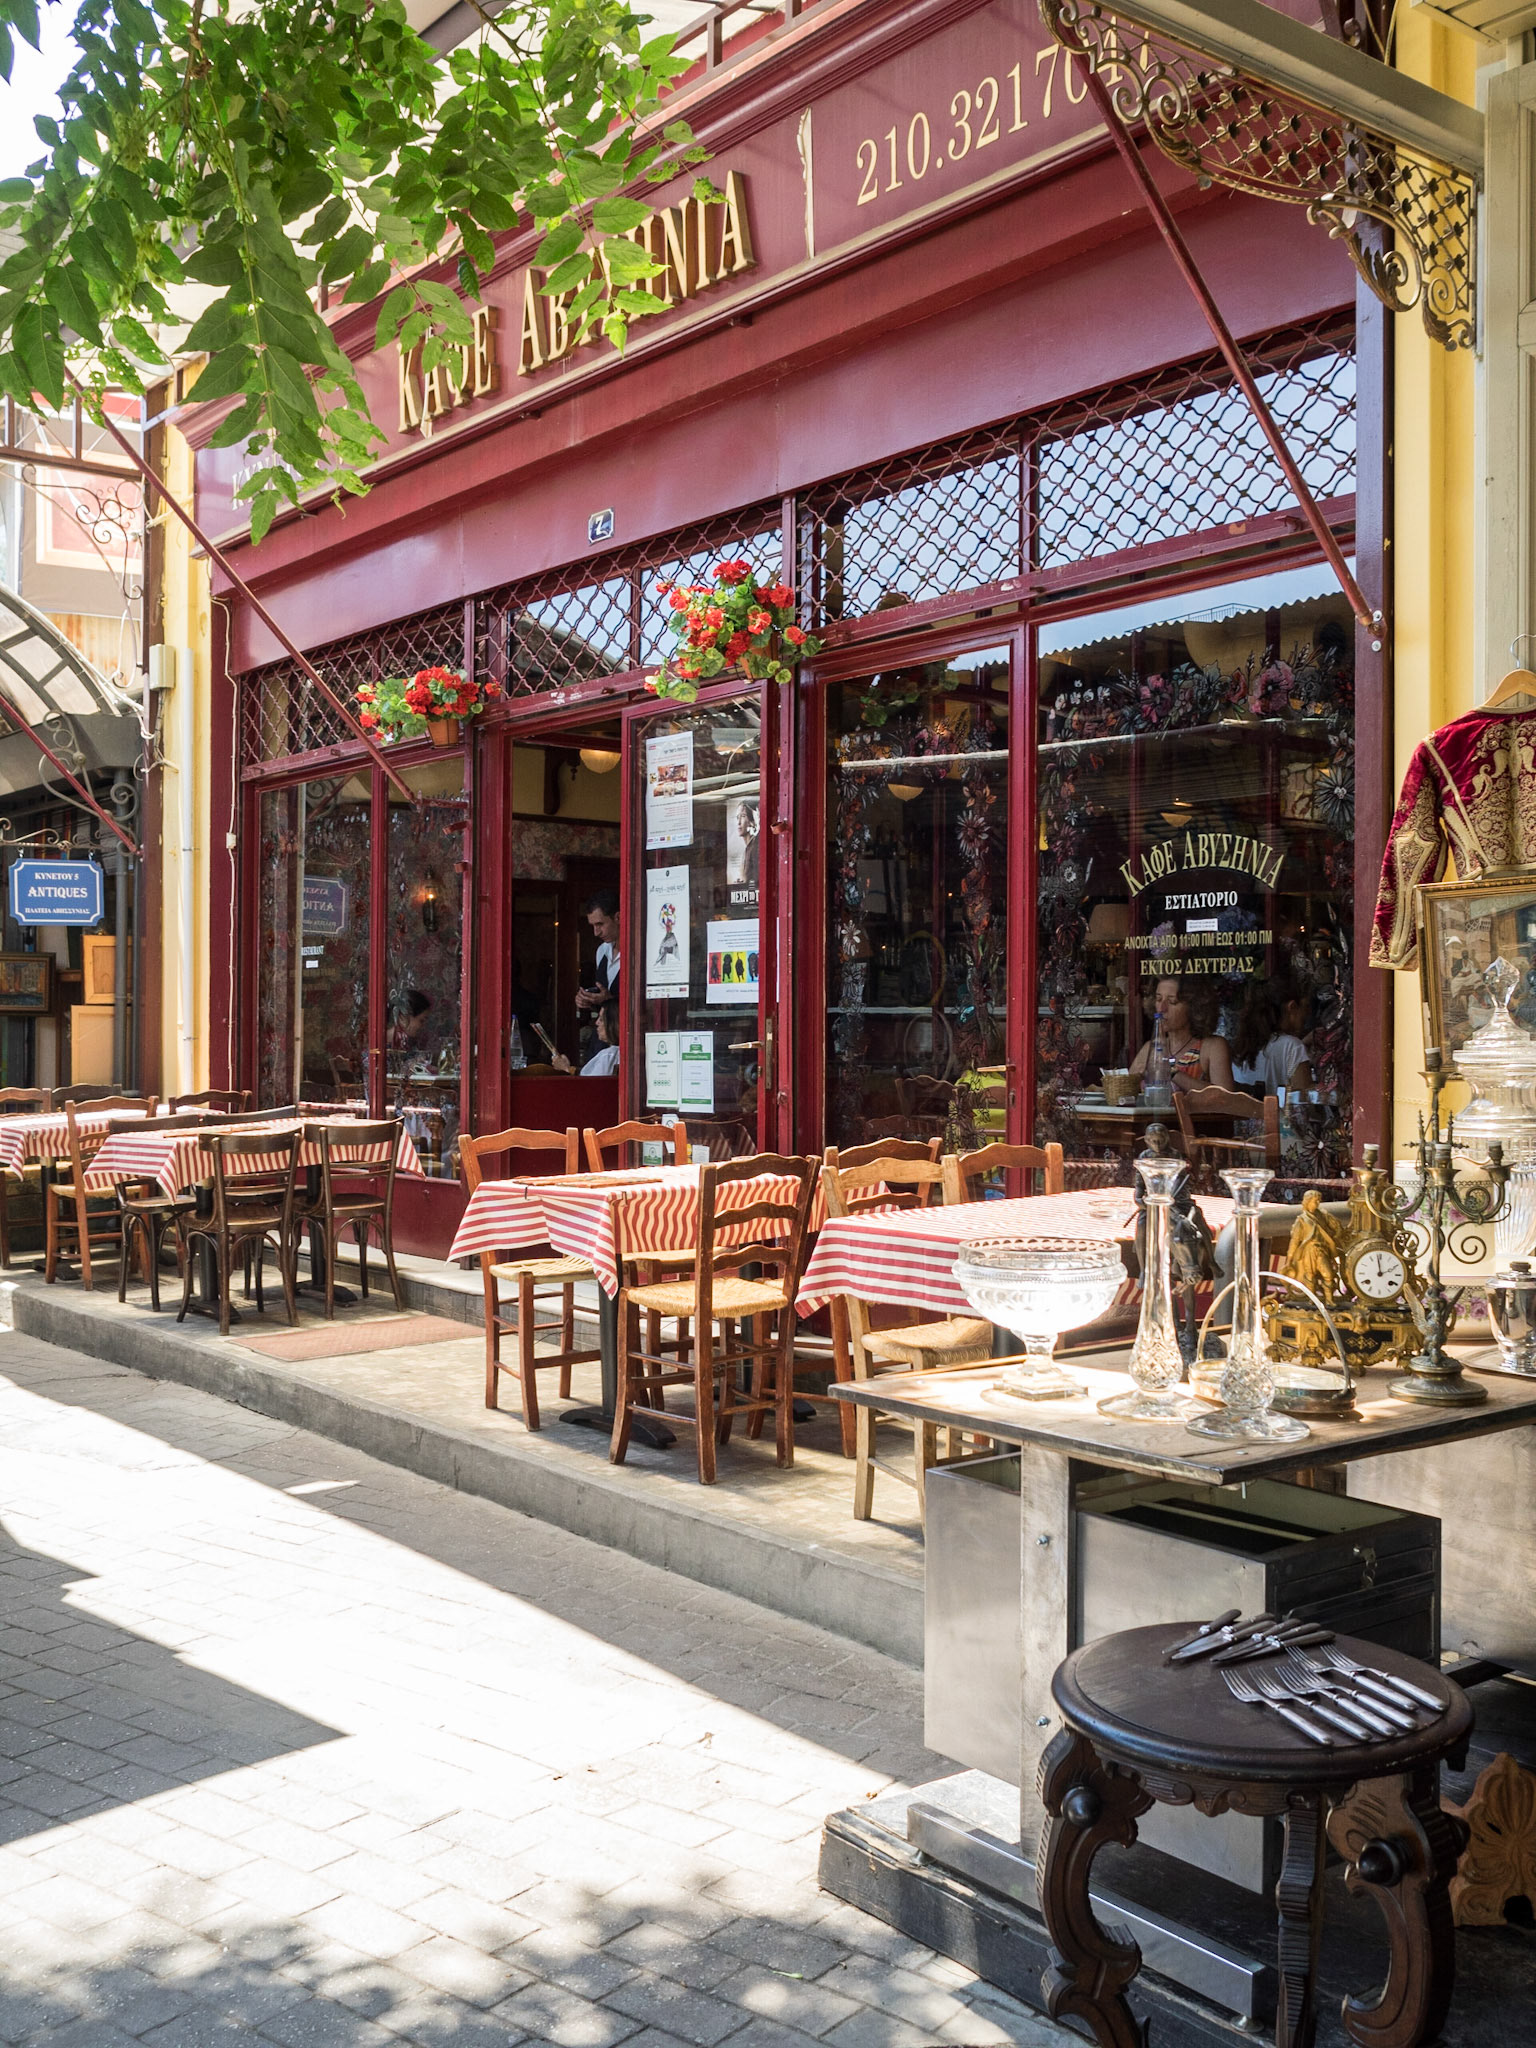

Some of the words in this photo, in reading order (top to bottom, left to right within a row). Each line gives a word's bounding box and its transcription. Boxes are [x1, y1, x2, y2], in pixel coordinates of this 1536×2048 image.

[1119, 840, 1177, 897] ΚΑΦΕ
[1183, 831, 1285, 889] ΑΒΥΣΗΝΙΑ
[28, 886, 88, 899] ANTIQUES
[1164, 891, 1238, 910] ΕΣΤΙΑΤΟΡΙΟ
[1124, 935, 1158, 950] ΑΝΟΙΧΤΑ
[1160, 935, 1178, 948] ΑΠΟ
[1216, 932, 1233, 946] ΕΩΣ
[1235, 931, 1257, 945] 01:00
[1140, 958, 1182, 976] ΕΚΤΟΣ
[1185, 956, 1254, 975] ΔΕΥΤΕΡΑΣ
